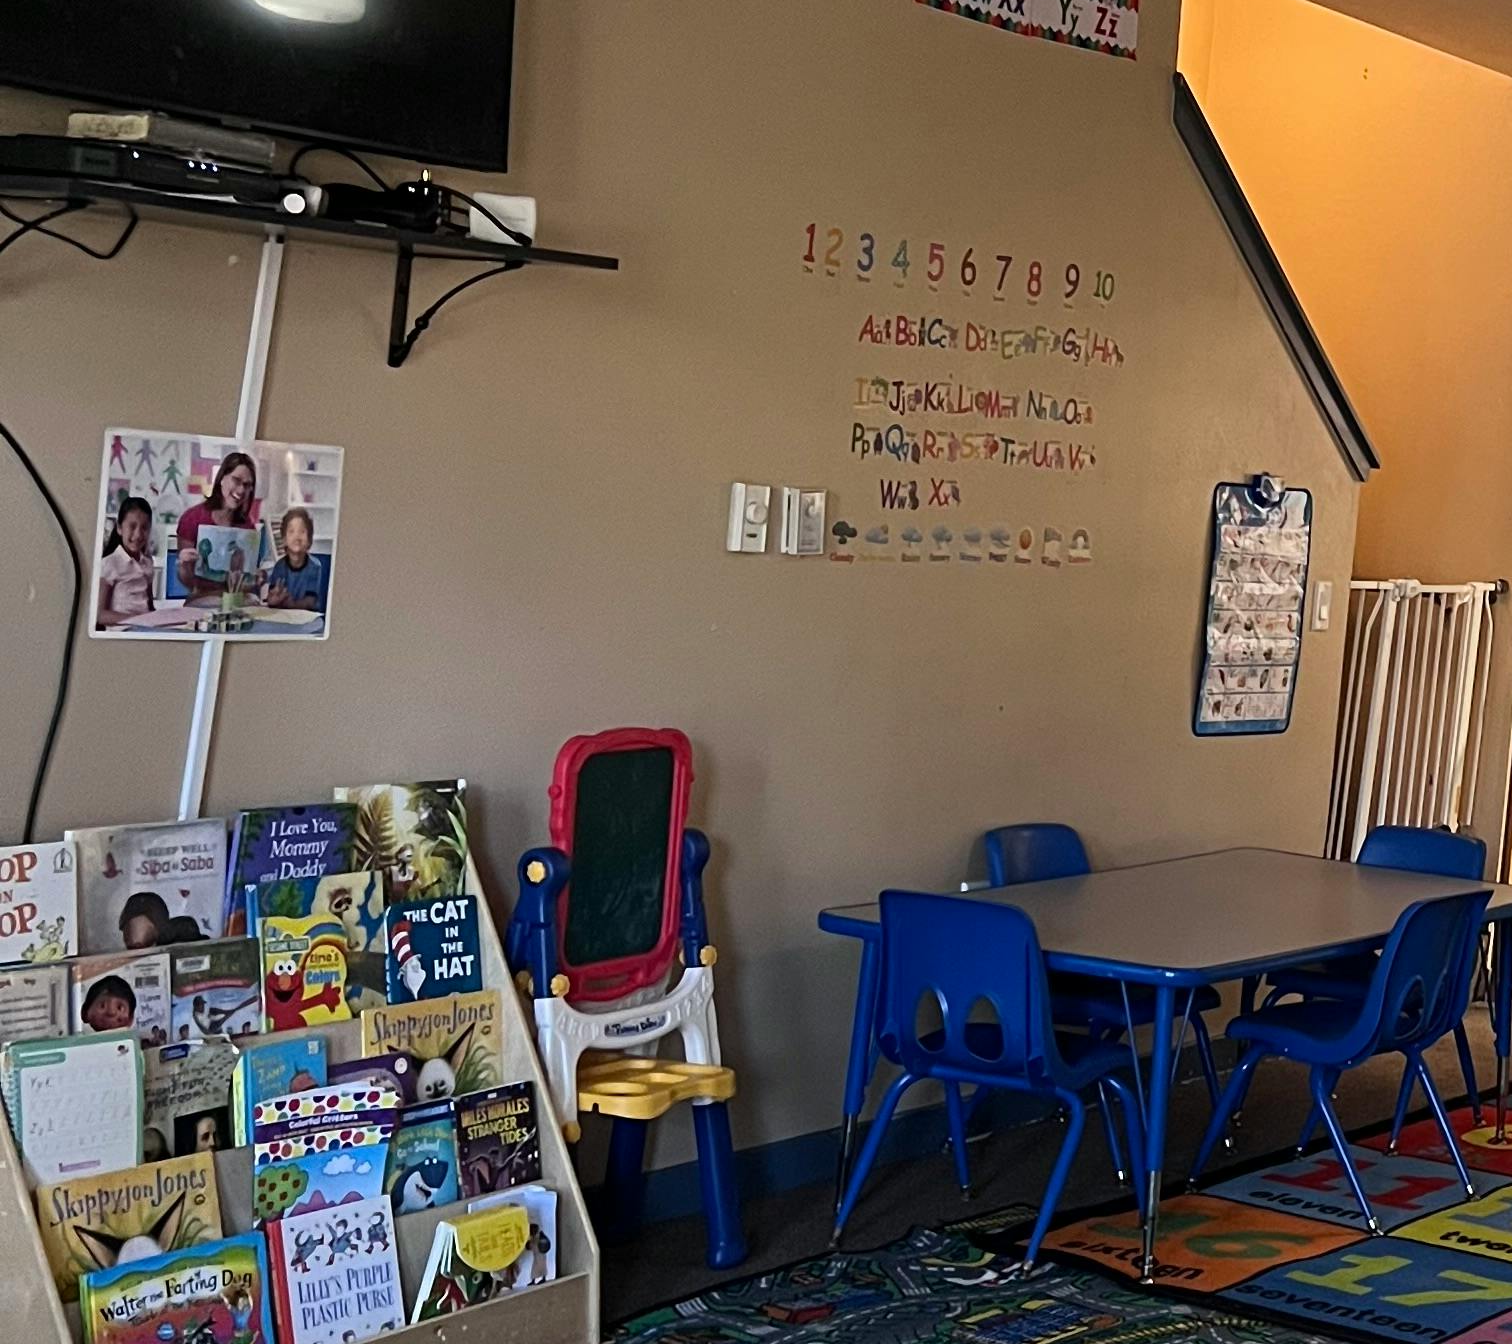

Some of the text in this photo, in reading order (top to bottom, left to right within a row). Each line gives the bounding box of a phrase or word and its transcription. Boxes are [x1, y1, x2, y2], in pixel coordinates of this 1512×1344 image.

[1095, 6, 1118, 39] Zz
[803, 223, 1116, 301] 1 2 3 4 5 6 7 8 9 10
[270, 822, 277, 838] I
[280, 821, 308, 837] Love
[270, 840, 329, 859] Mommy
[280, 861, 327, 882] Daddy
[404, 899, 469, 924] THE CAT
[445, 926, 459, 938] IN
[441, 941, 463, 954] THE
[434, 955, 475, 981] HAT
[467, 1117, 518, 1141] STRANGER
[500, 1127, 529, 1145] TIDES
[297, 1261, 393, 1304] LILLY'S PURPLE
[100, 1296, 150, 1322] Walter
[165, 1270, 217, 1298] Farting
[302, 1287, 394, 1329] PLASTIC PURSE
[1234, 1282, 1448, 1343] seventeen
